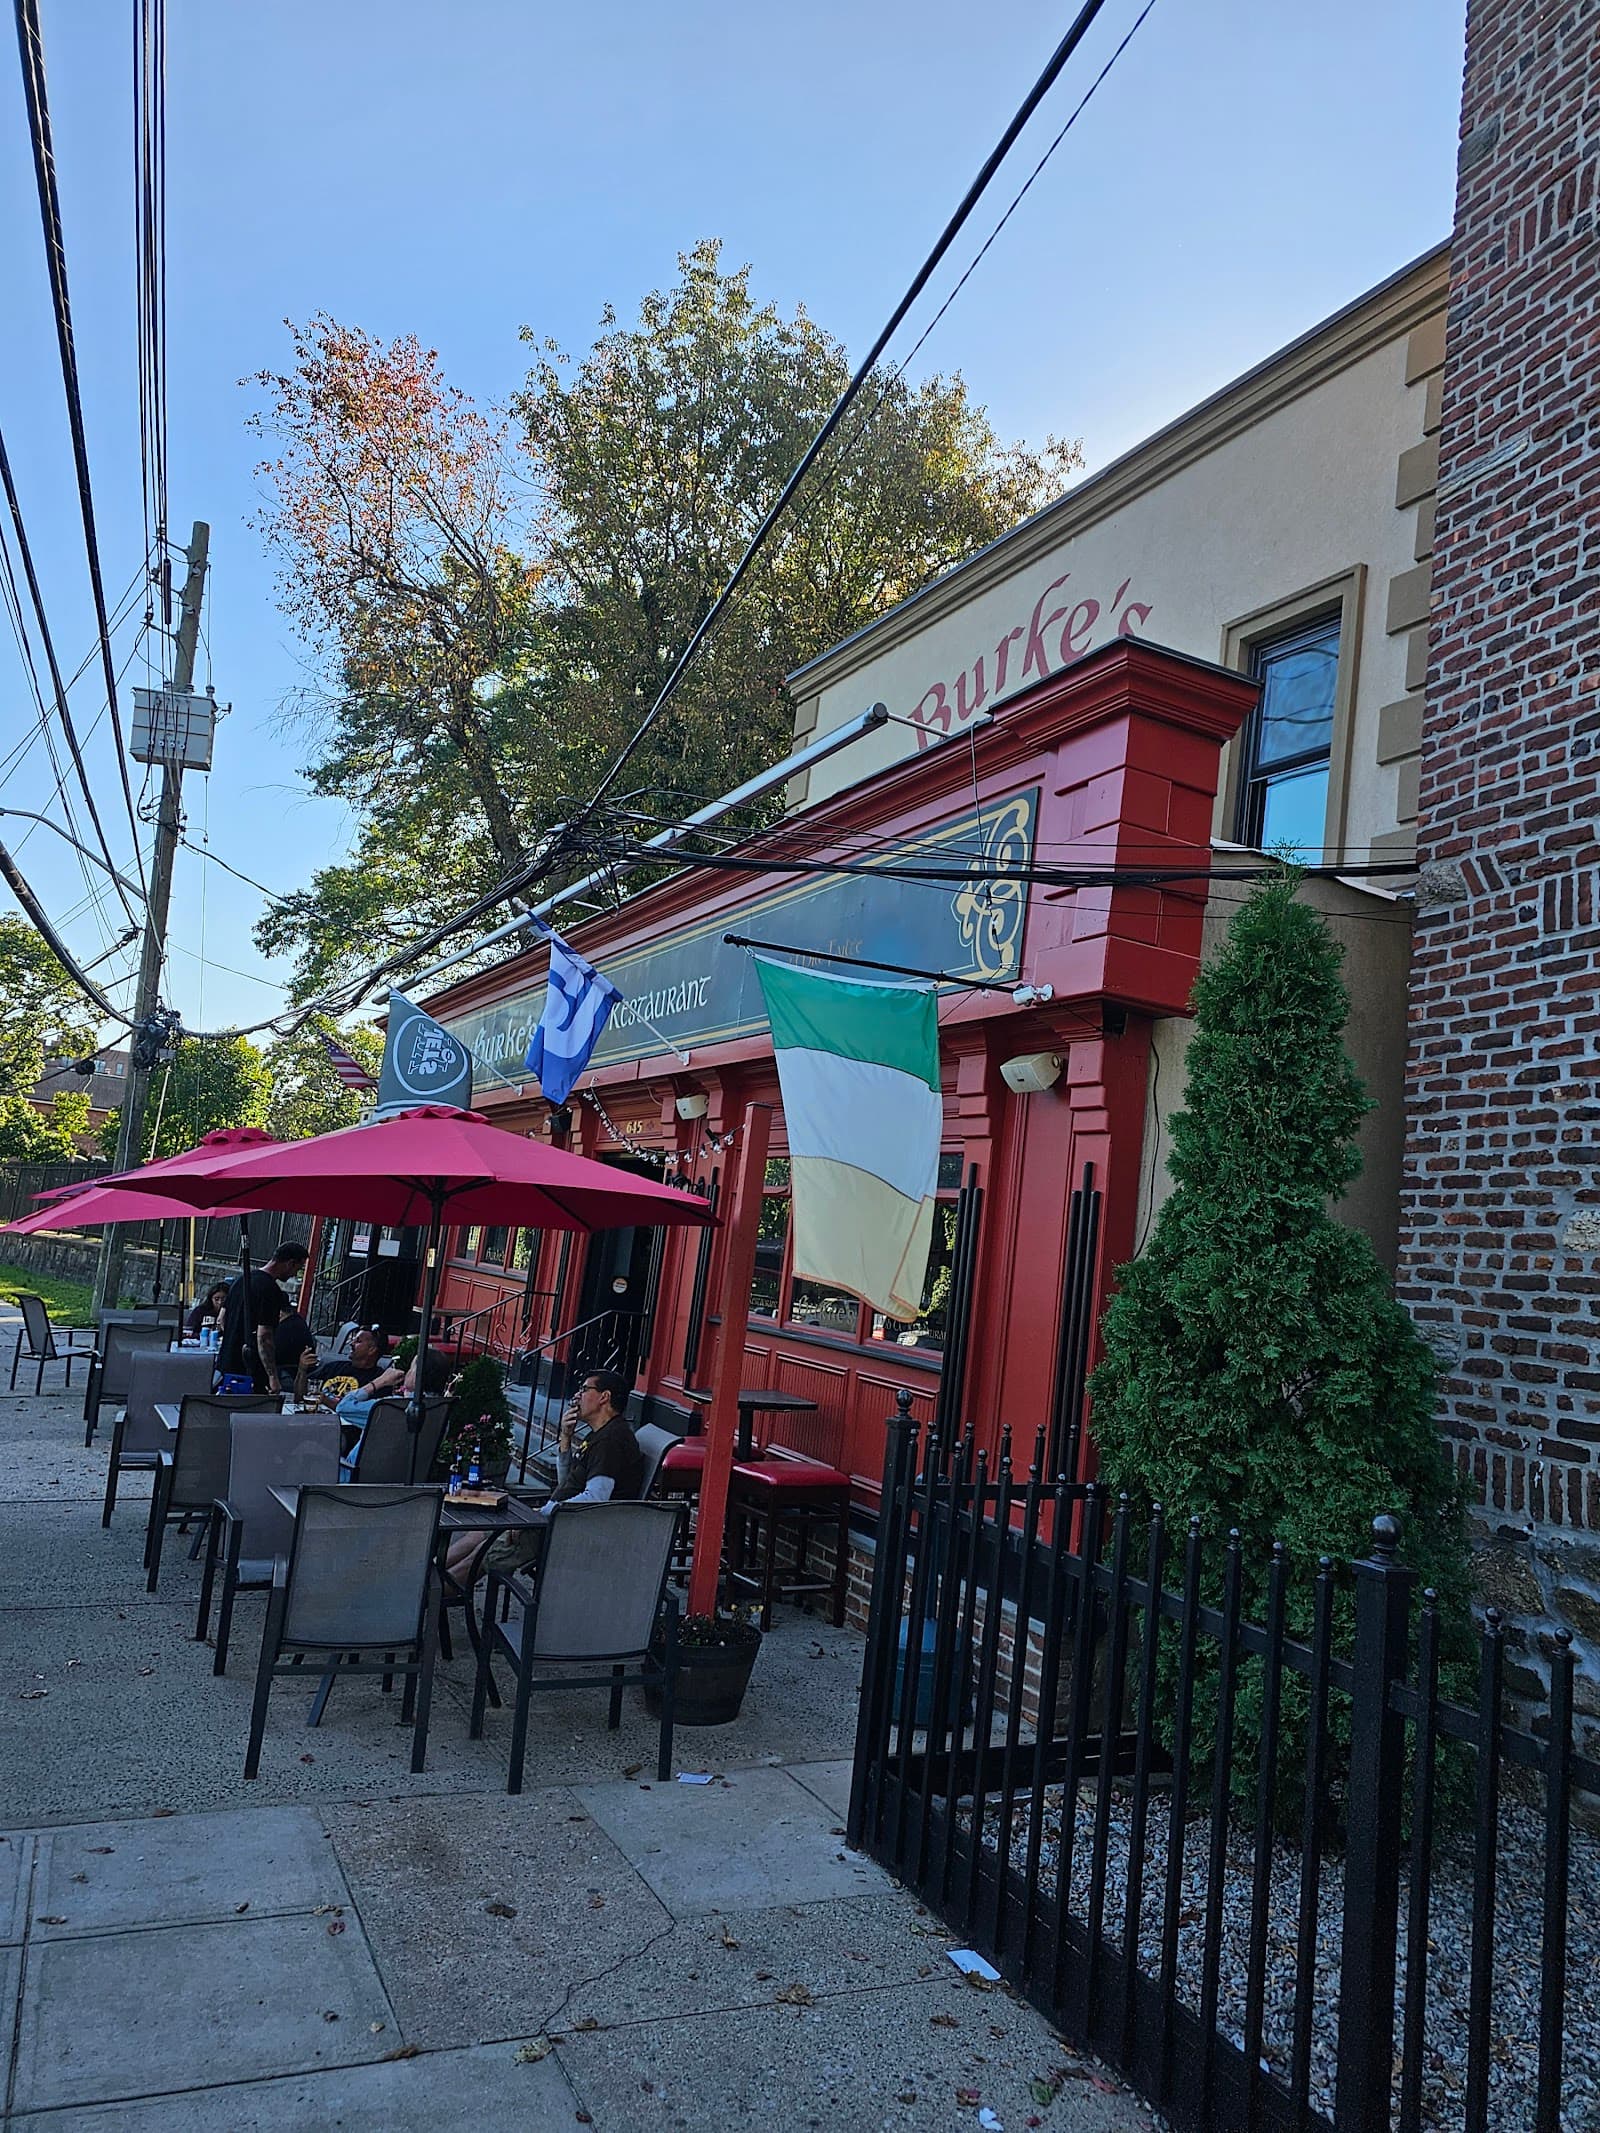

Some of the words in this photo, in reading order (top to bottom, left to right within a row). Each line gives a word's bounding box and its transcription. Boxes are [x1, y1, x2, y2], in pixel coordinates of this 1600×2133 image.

[471, 1014, 538, 1071] Burke's
[608, 975, 712, 1031] Restaurant
[626, 1120, 643, 1134] 645
